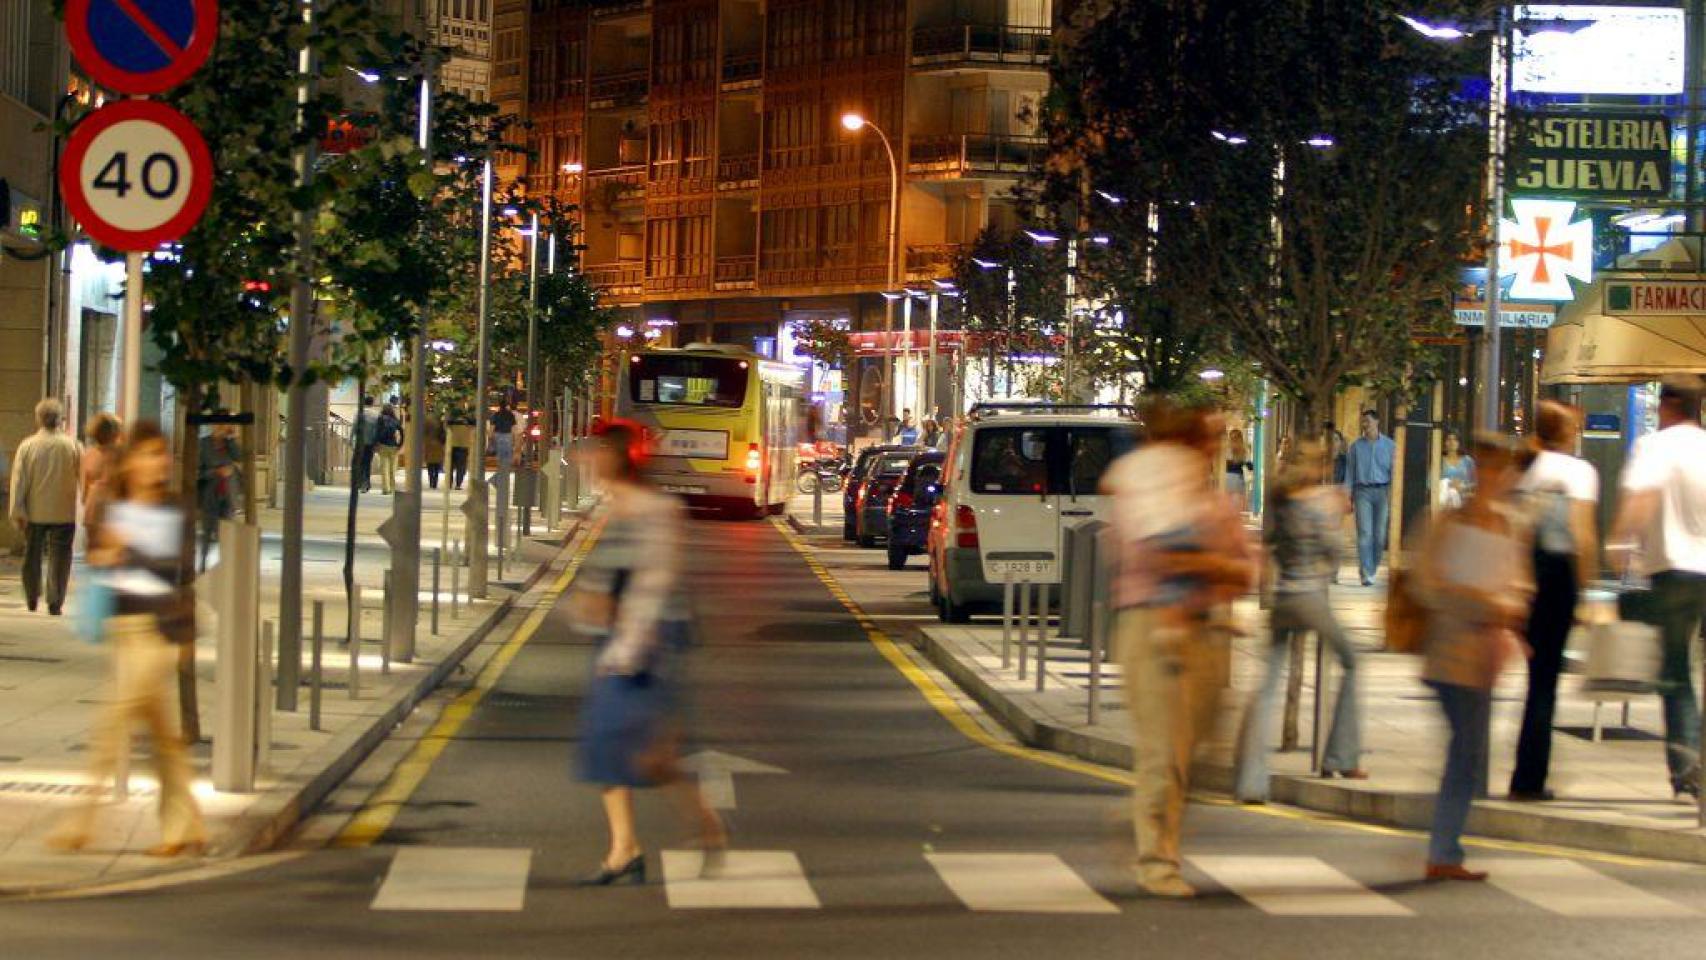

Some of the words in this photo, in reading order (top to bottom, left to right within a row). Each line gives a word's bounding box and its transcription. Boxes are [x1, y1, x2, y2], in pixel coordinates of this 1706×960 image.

[1511, 118, 1669, 150] ASTELERIA
[93, 152, 179, 199] 40
[1516, 158, 1662, 191] SUEVIA
